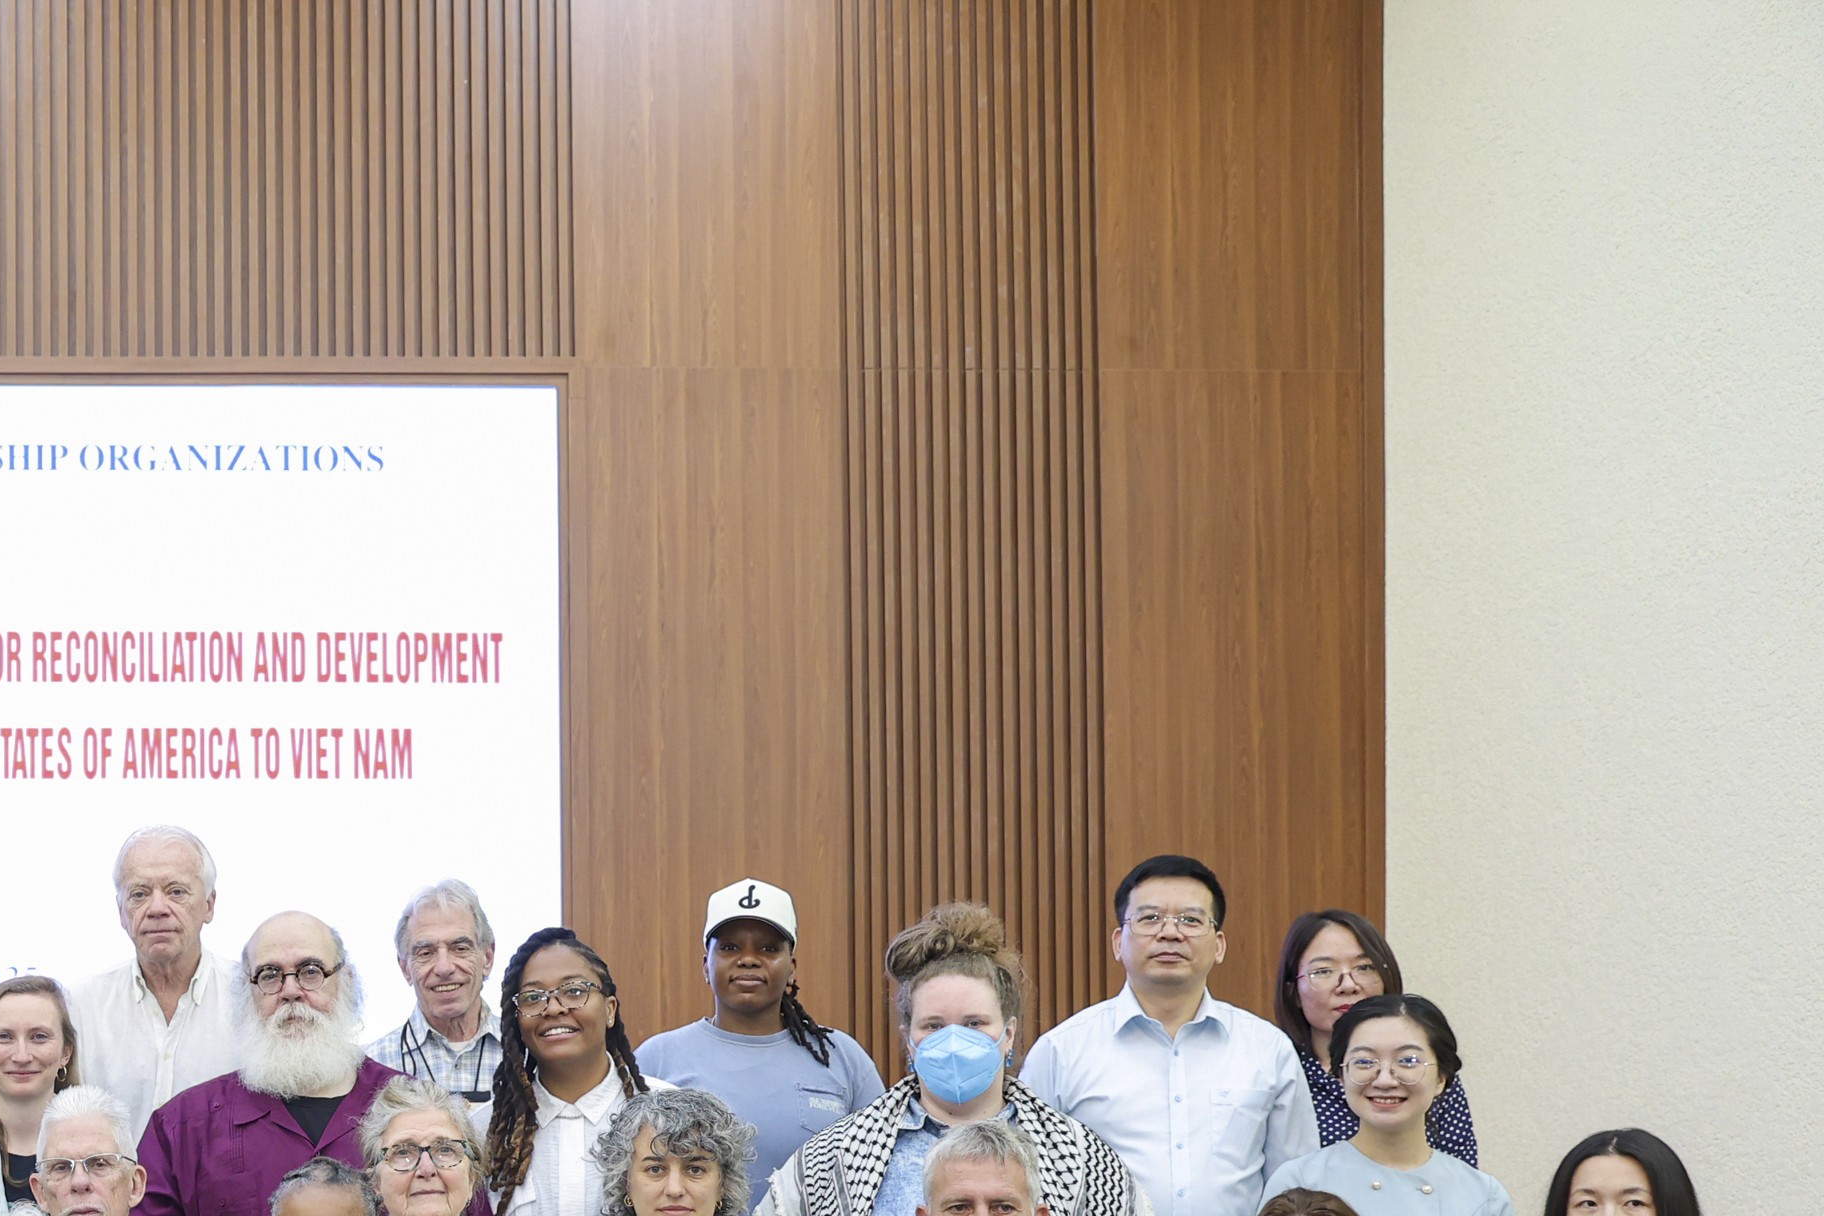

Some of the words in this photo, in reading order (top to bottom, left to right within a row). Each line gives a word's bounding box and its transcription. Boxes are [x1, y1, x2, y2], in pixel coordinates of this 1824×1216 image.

[79, 444, 384, 472] ORGANIZATIONS
[33, 631, 242, 684] RECONCILIATION
[254, 631, 305, 684] AND
[317, 631, 503, 684] DEVELOPMENT
[83, 728, 112, 780] OF
[123, 728, 241, 780] AMERICA
[250, 728, 280, 780] TO
[290, 728, 343, 780] VIET
[354, 728, 412, 780] NAM
